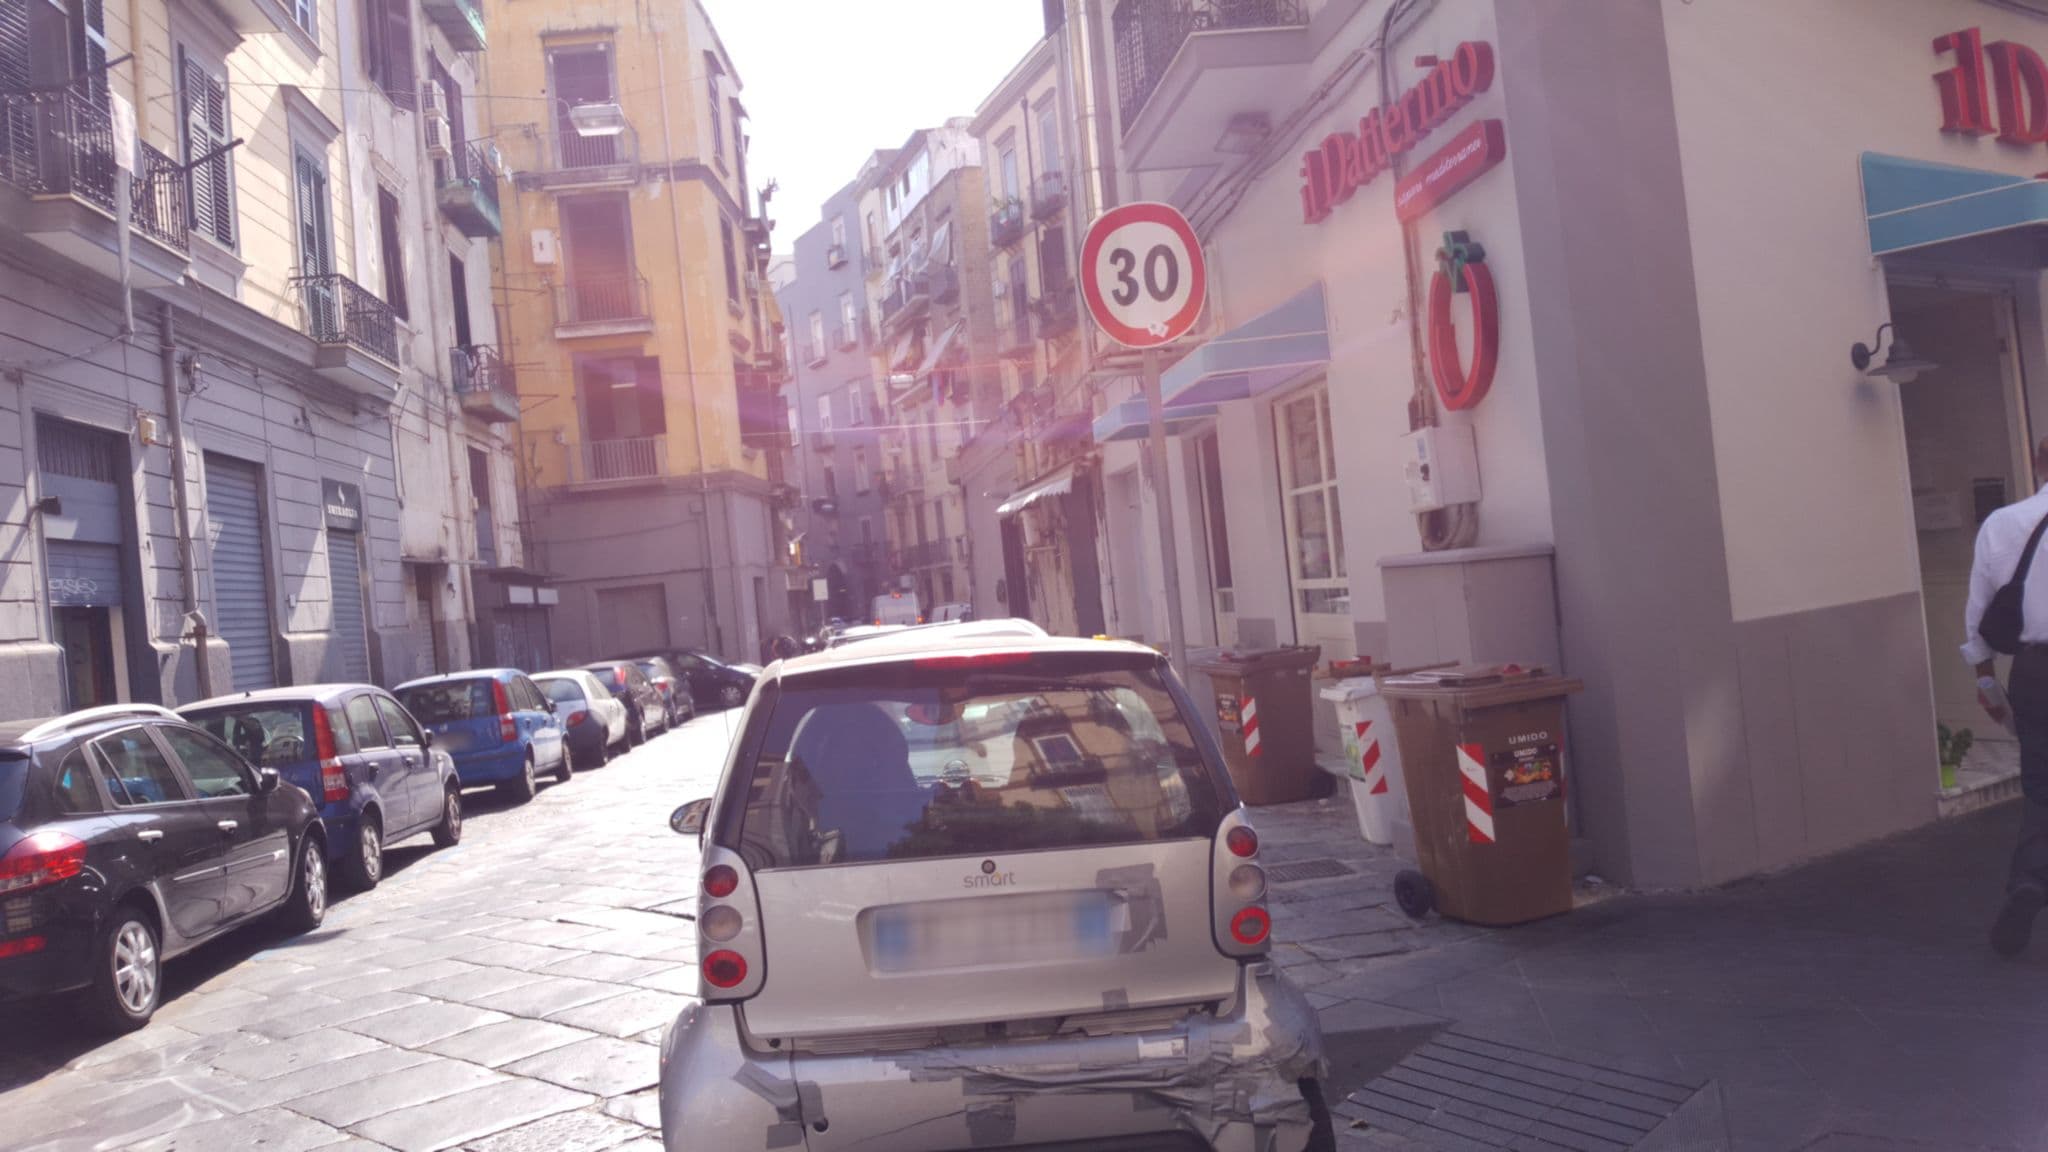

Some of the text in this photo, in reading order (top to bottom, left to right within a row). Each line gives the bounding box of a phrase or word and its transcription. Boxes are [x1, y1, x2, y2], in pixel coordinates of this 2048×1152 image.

[1109, 244, 1179, 307] 30
[1508, 731, 1548, 745] UMIDO
[1513, 747, 1538, 758] UMIDO
[963, 871, 1017, 889] smart
